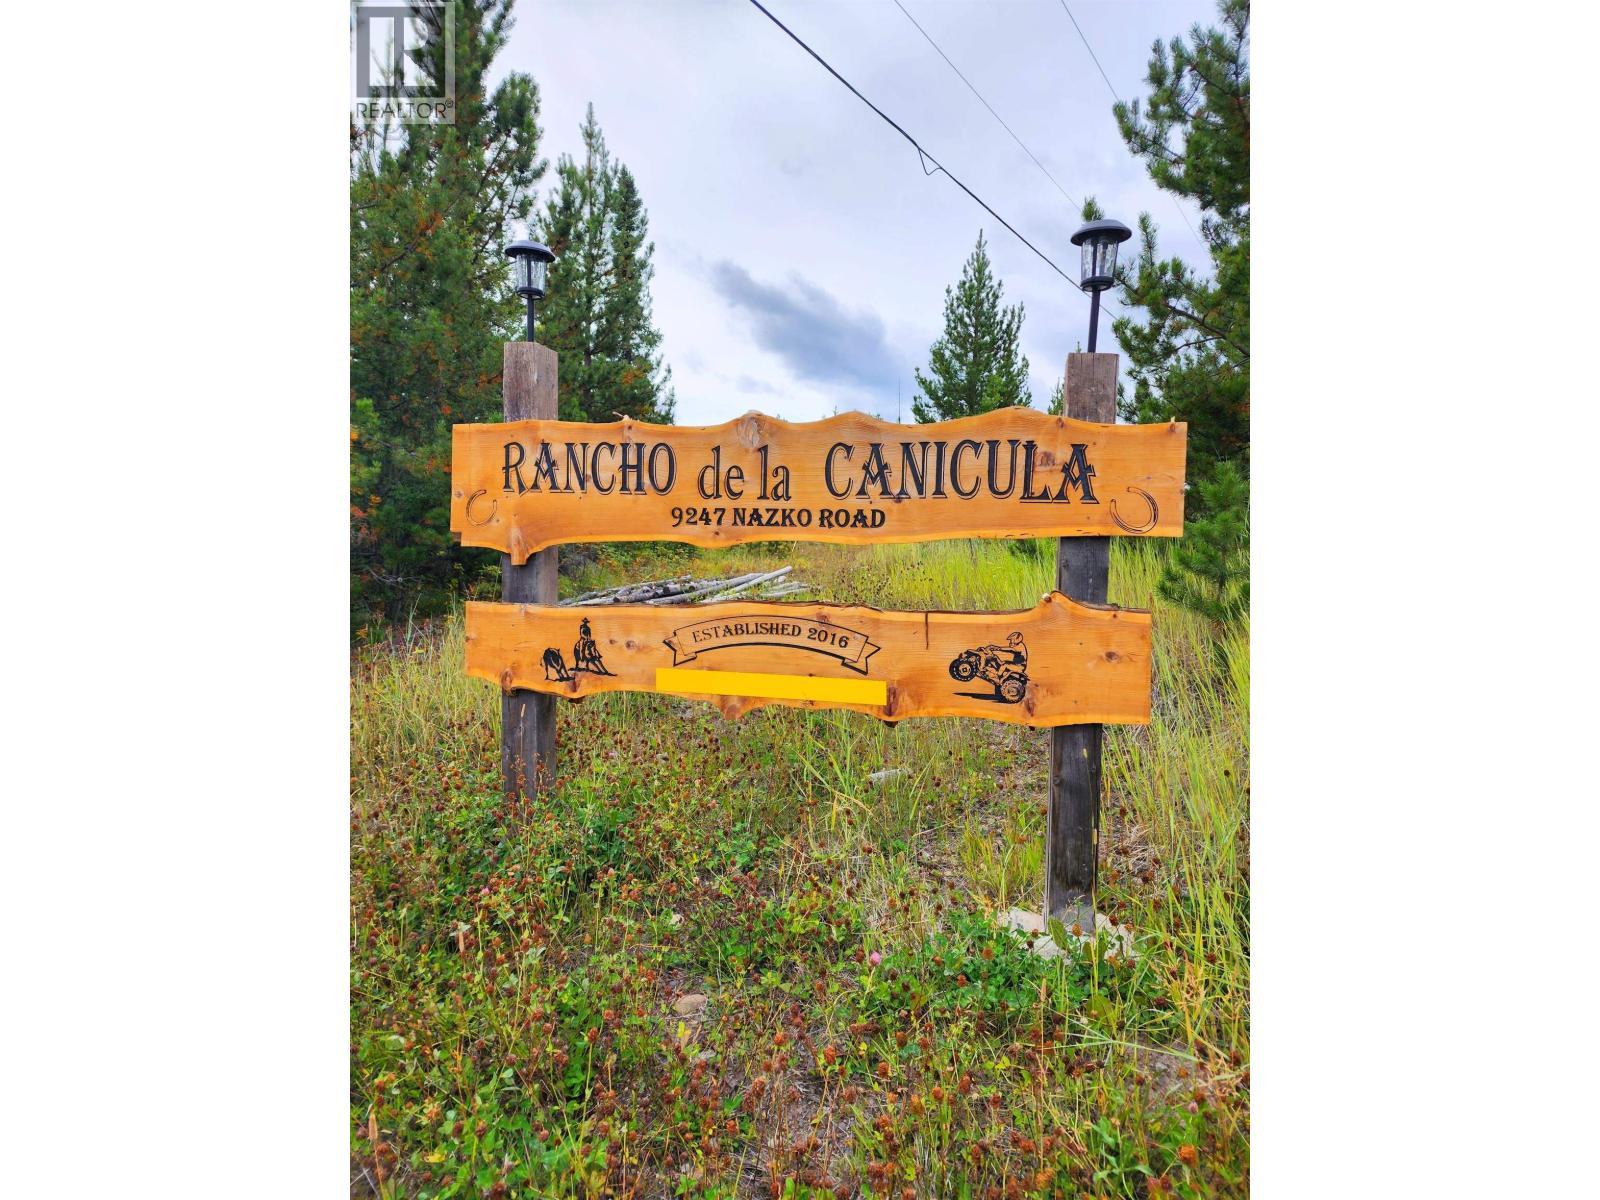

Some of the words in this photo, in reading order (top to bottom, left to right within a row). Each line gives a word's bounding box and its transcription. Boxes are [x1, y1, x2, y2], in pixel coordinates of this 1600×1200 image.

[502, 440, 677, 495] RANCHO
[698, 445, 745, 500] de
[757, 444, 792, 501] la
[825, 439, 1100, 504] CANICULA
[671, 507, 726, 527] 9247
[732, 507, 812, 527] NAZKO
[819, 508, 886, 529] ROAD
[692, 622, 801, 643] ESTABLISHED
[807, 627, 850, 648] 2016
